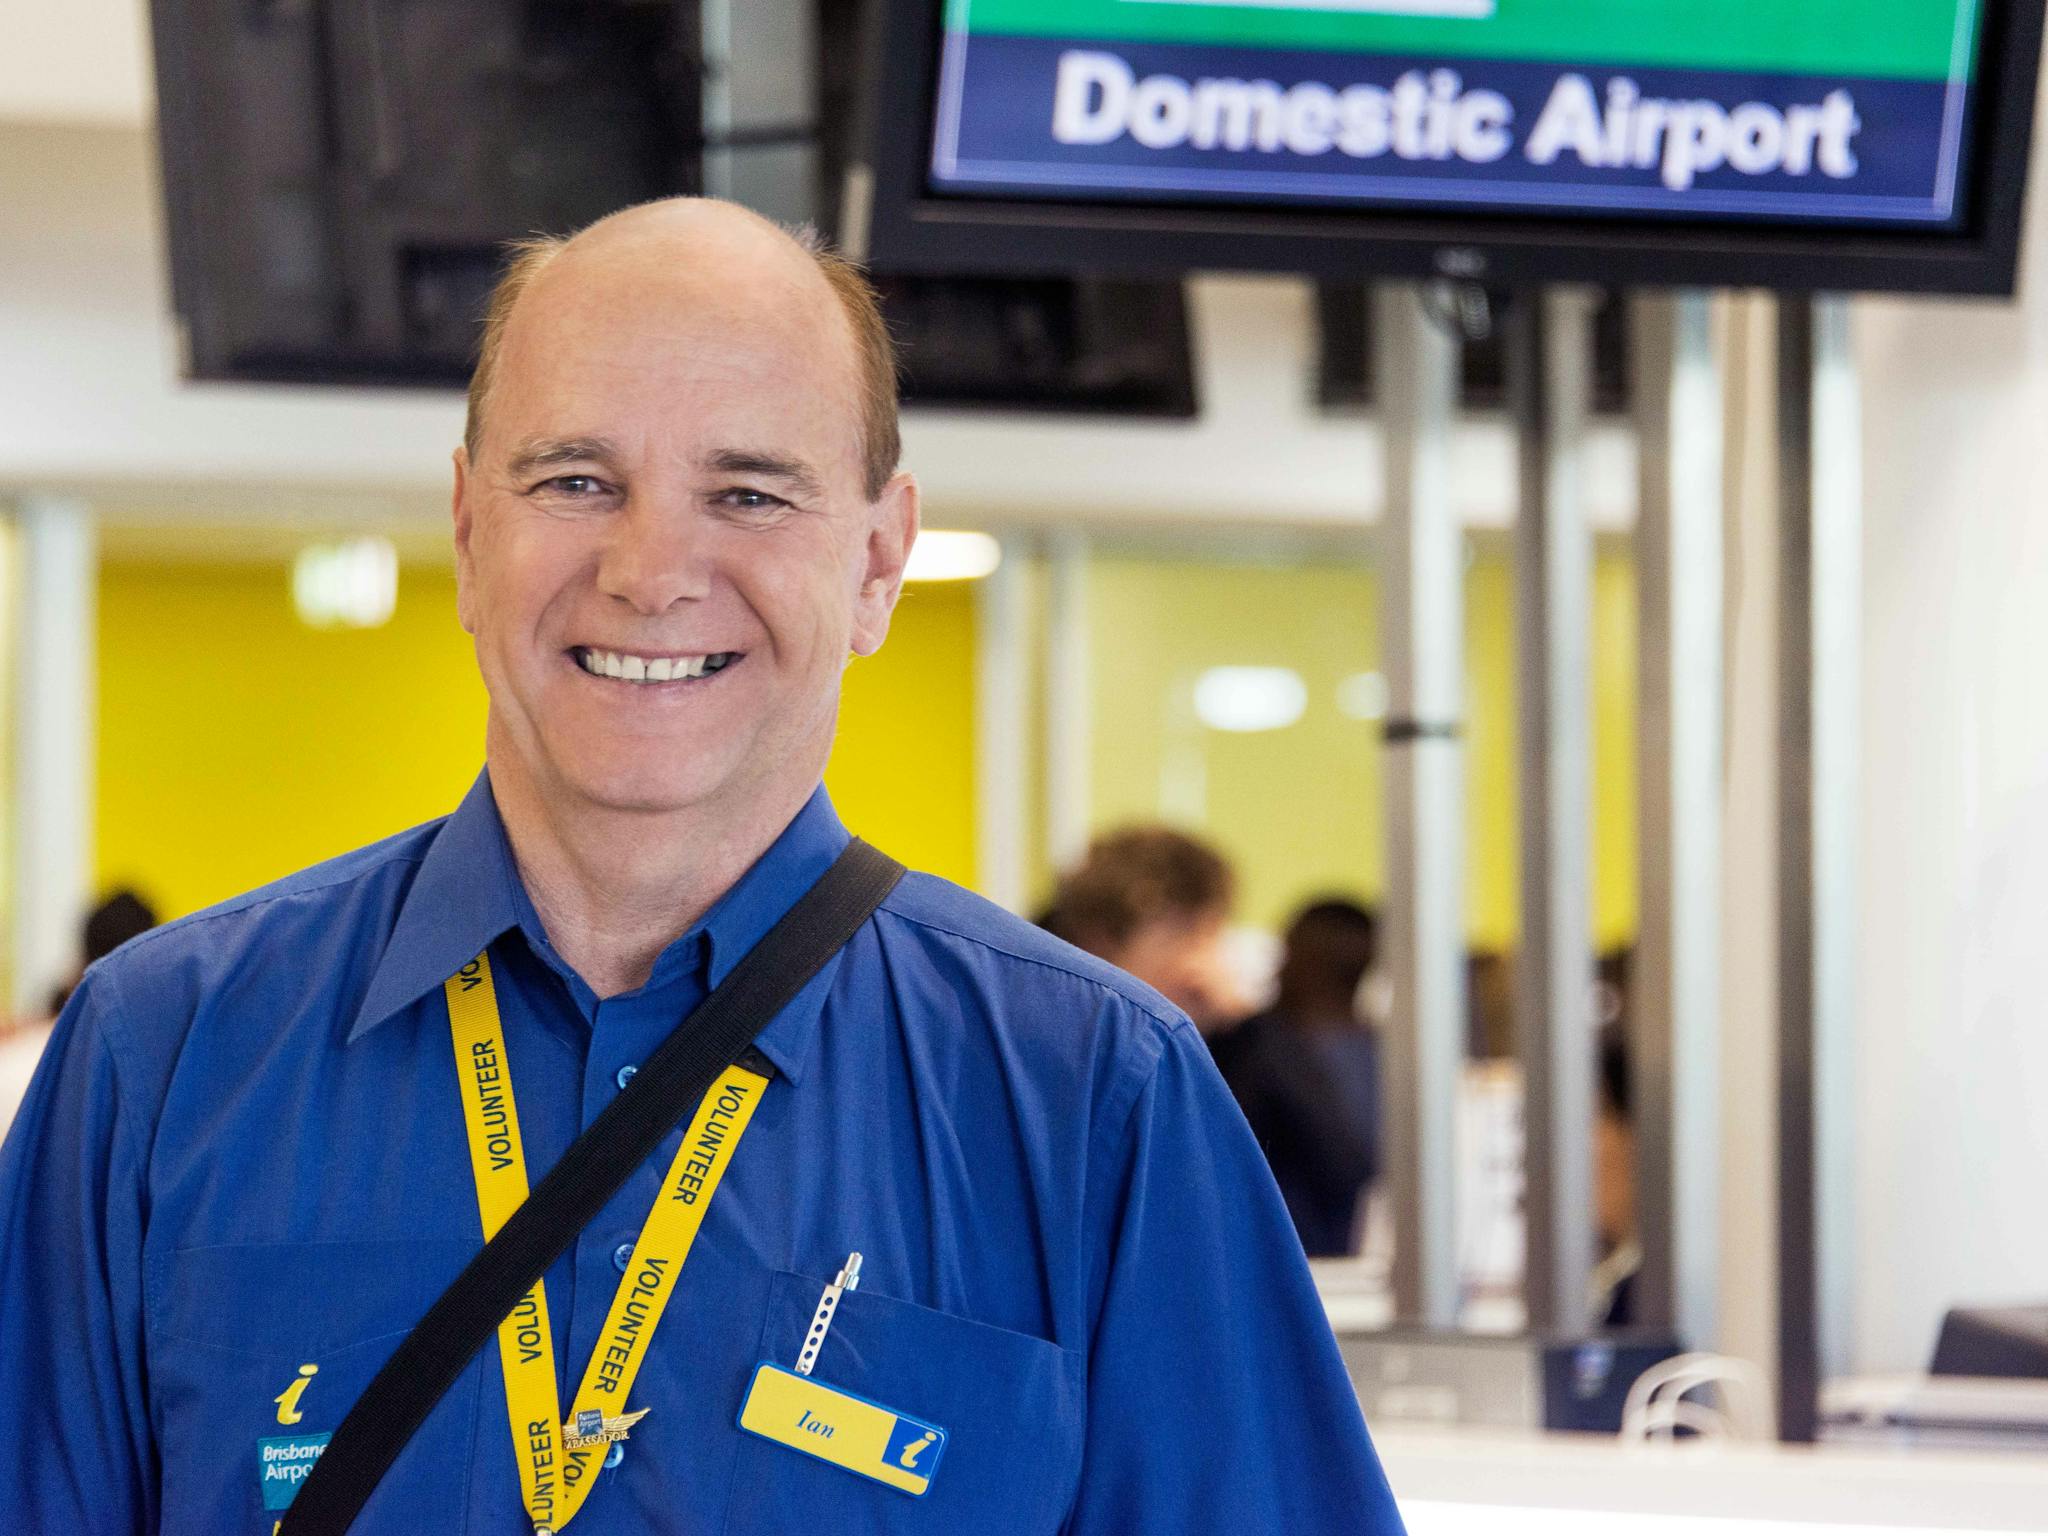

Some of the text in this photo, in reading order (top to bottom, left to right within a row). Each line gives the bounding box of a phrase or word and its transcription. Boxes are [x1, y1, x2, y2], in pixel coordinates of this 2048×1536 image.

[1052, 50, 1859, 190] Domestic Airport
[472, 1038, 513, 1171] VOLUNTEER
[672, 1084, 748, 1205] VOLUNTEER
[514, 1294, 542, 1364] VOLU
[594, 1257, 668, 1394] VOLUNTEER
[795, 1409, 835, 1439] Ian
